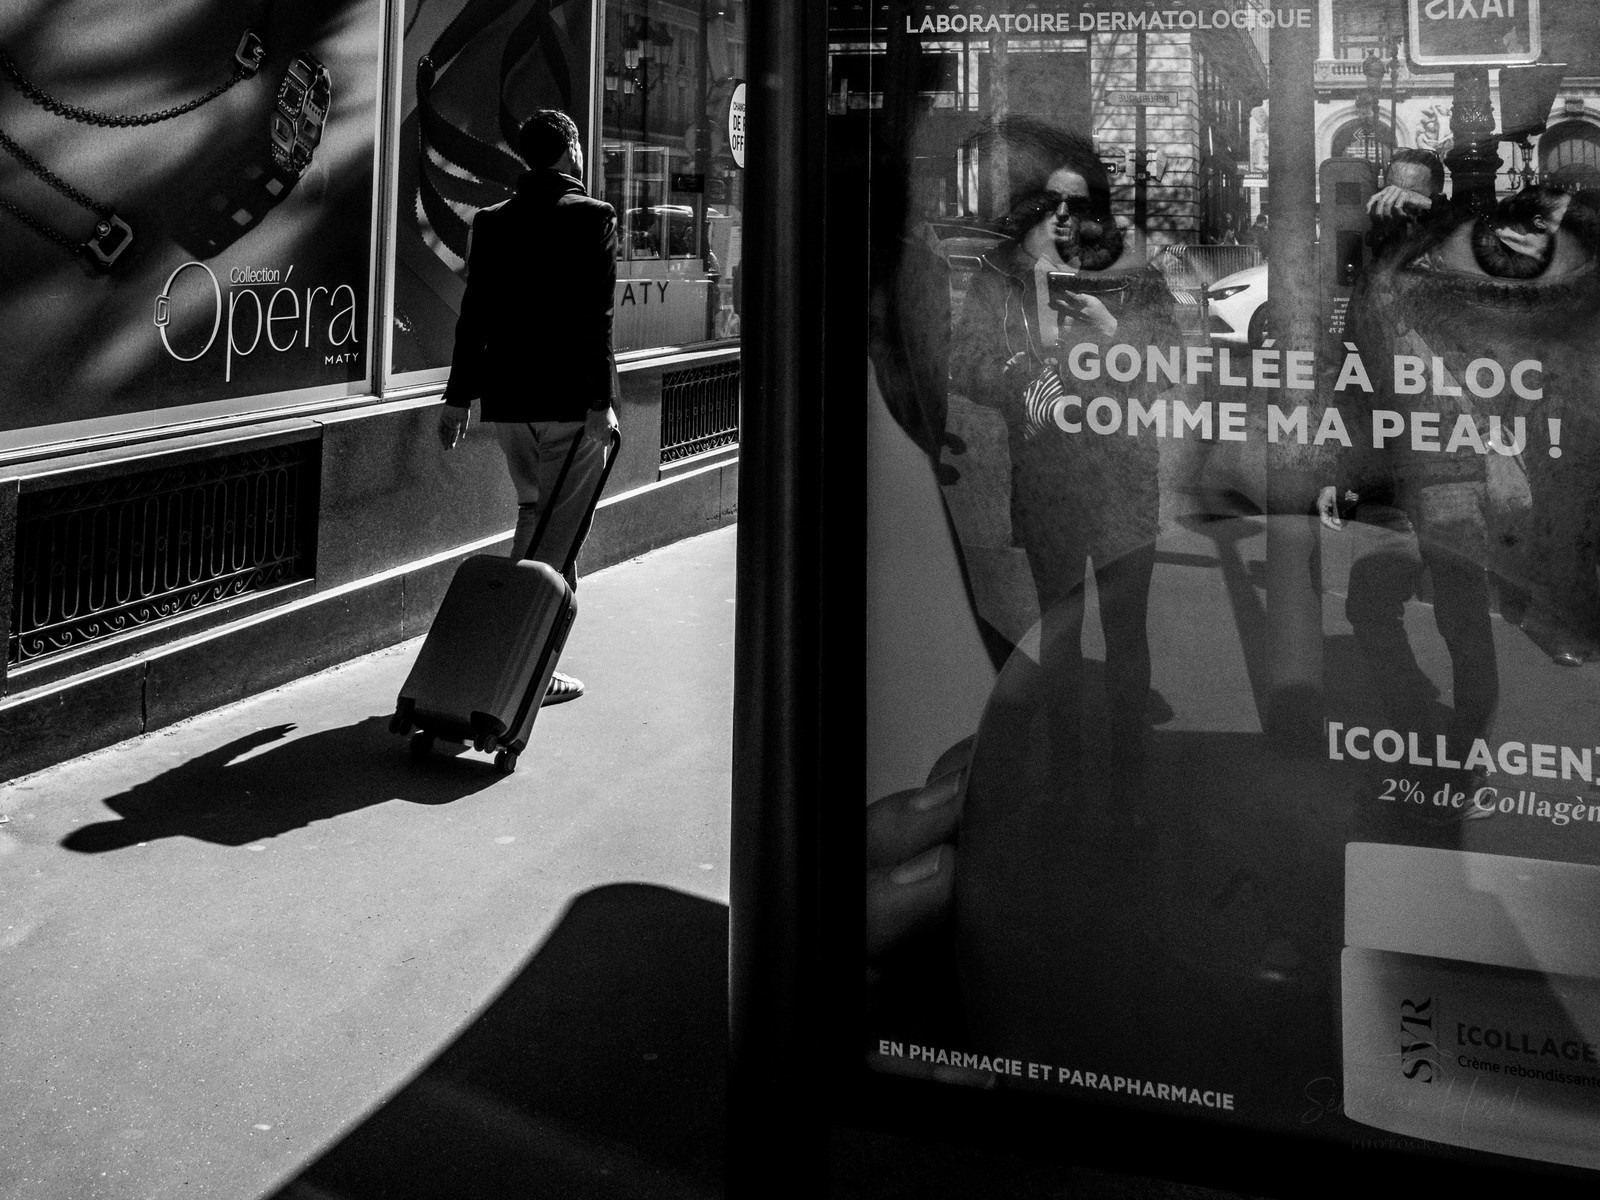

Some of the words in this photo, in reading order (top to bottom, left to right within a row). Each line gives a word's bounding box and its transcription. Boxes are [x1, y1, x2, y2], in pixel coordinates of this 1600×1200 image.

[906, 13, 1070, 34] LABORATOIRE
[1078, 8, 1312, 33] DERMATOLOGIQUE
[230, 266, 280, 284] Collection
[620, 281, 669, 306] ATY
[154, 262, 359, 383] Opéra
[324, 352, 359, 366] MATY
[1068, 339, 1315, 390] GONFLÉE
[1334, 341, 1374, 393] À
[1393, 354, 1544, 400] BLOC
[1053, 395, 1247, 442] COMME
[1266, 405, 1353, 448] MA
[1372, 409, 1527, 457] PEAU
[1547, 418, 1562, 459] !
[1377, 778, 1425, 805] 2%
[1432, 782, 1466, 808] de
[1400, 996, 1432, 1084] SVR
[1457, 1022, 1598, 1063] [COLLAGE
[879, 1040, 904, 1058] EN
[909, 1044, 1022, 1077] PHARMACIE
[1028, 1062, 1053, 1081] ET
[1058, 1067, 1235, 1111] PARAPHARMACIE
[1457, 1055, 1501, 1074] Crème
